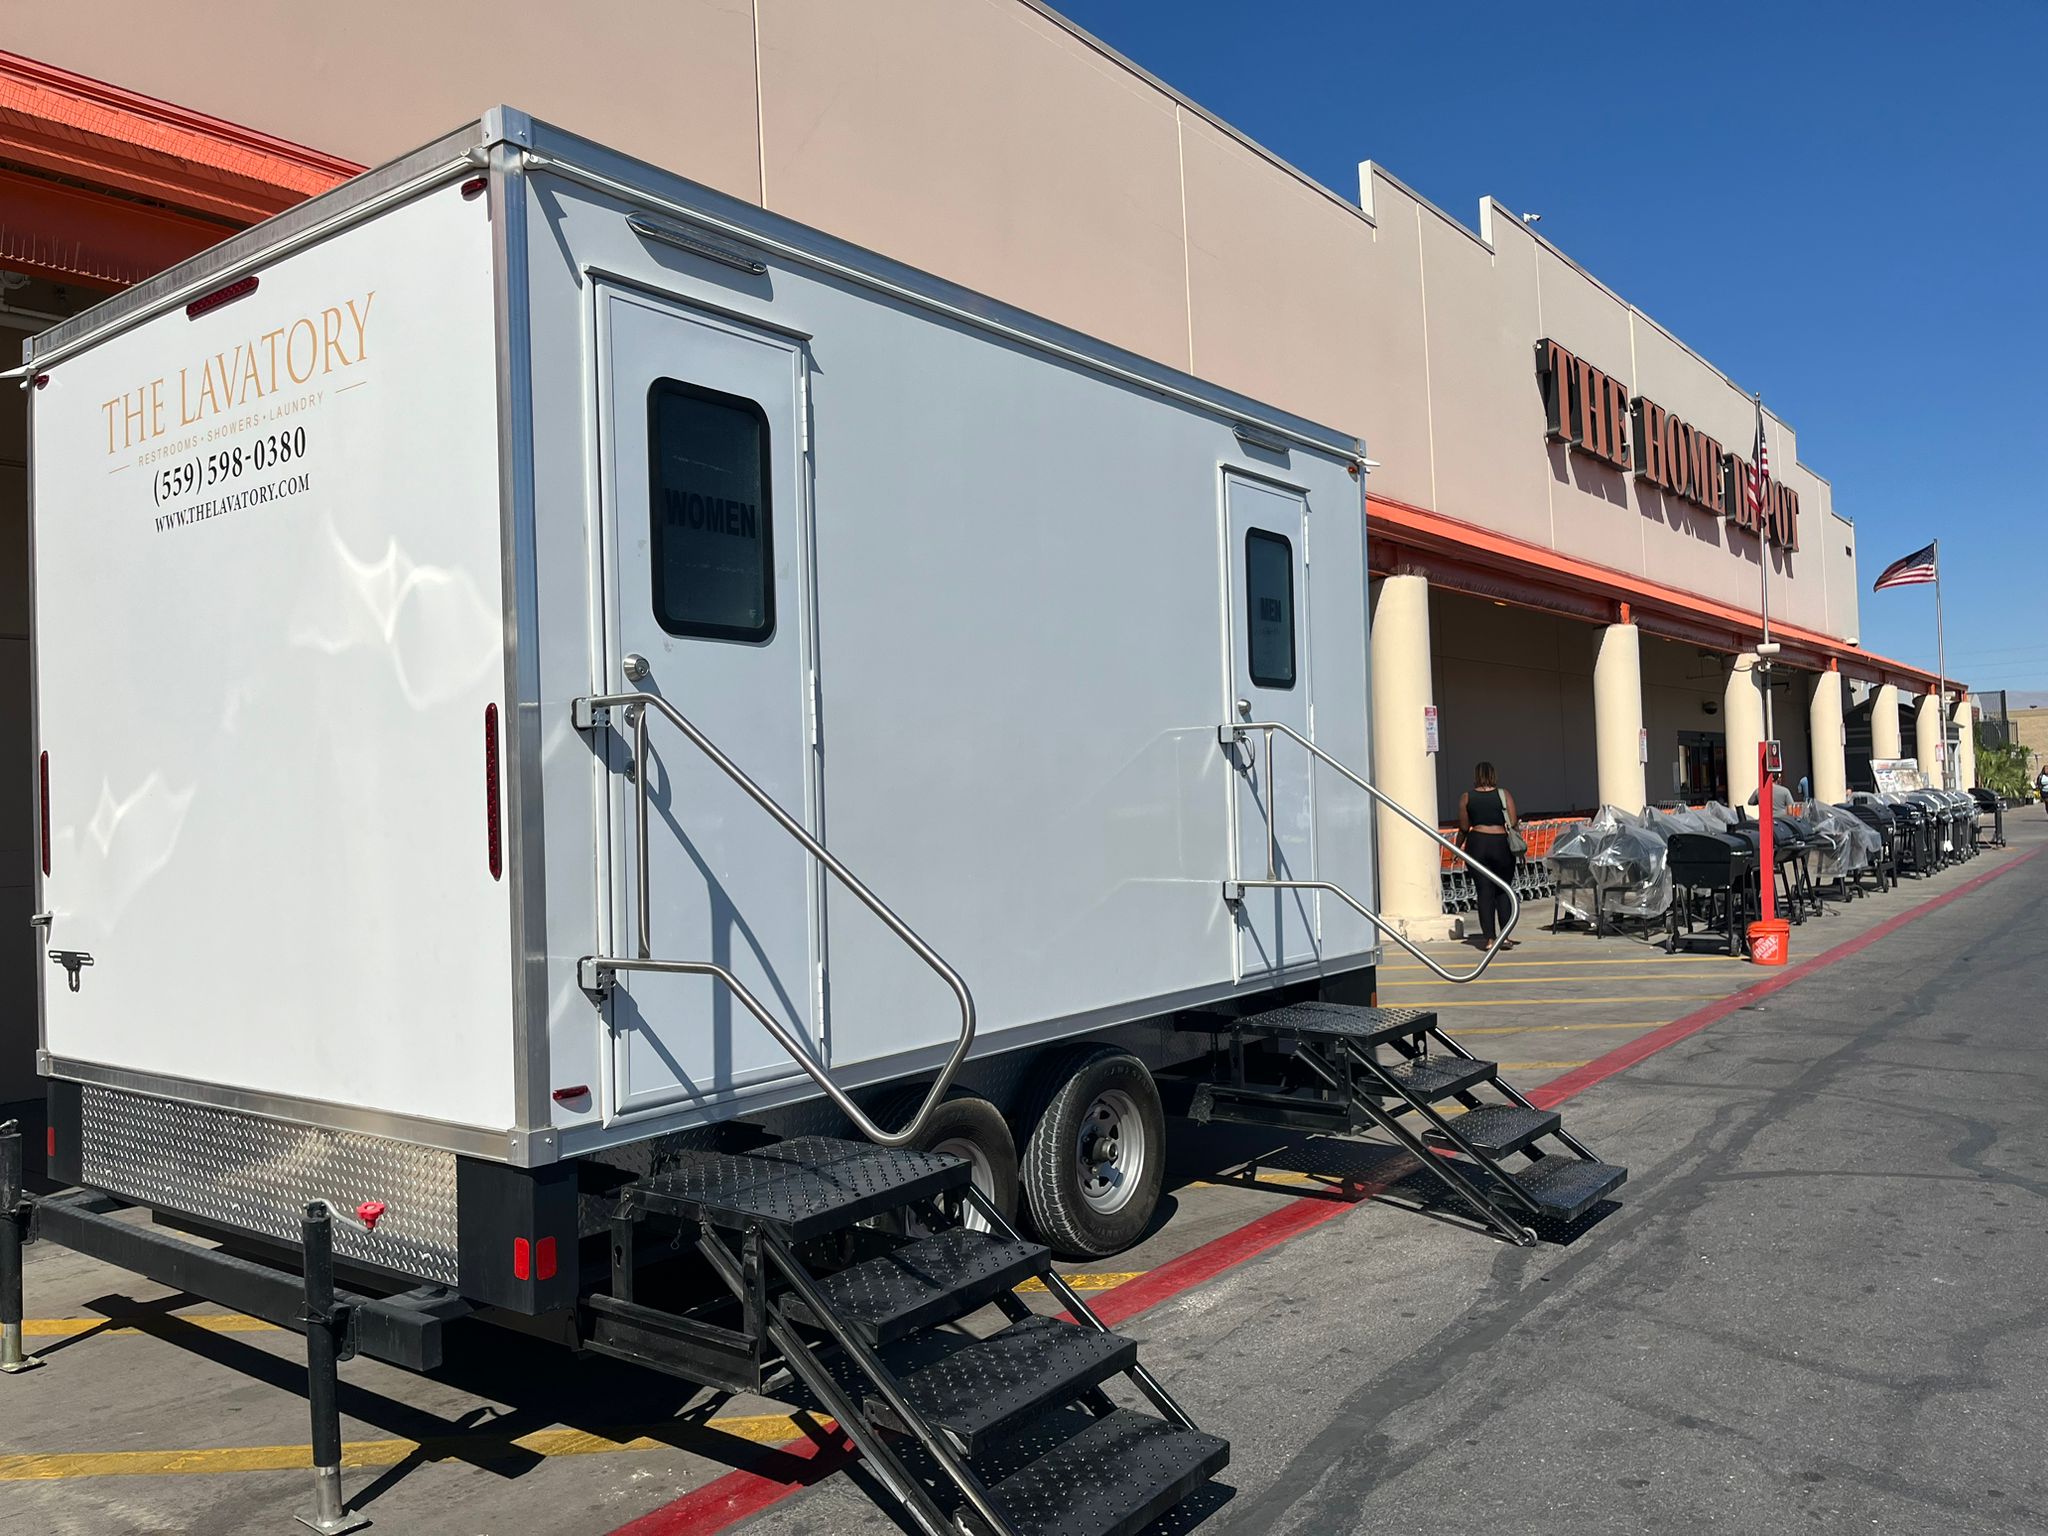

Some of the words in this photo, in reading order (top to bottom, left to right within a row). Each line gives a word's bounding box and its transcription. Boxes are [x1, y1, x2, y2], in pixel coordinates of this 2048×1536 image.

[102, 378, 166, 455] THE
[179, 291, 376, 426] LAVATORY
[138, 435, 198, 467] RESTROOMS
[207, 414, 260, 443] SHOWERS
[269, 391, 325, 421] LAUNDRY
[153, 456, 203, 507] (559)
[207, 426, 307, 486] 598-0380
[1537, 338, 1632, 472] THE
[1631, 396, 1726, 516] HOME
[1723, 453, 1799, 553] DPOT
[154, 473, 311, 533] WWW.THELAVATORY.COM
[664, 488, 756, 539] WOMEN
